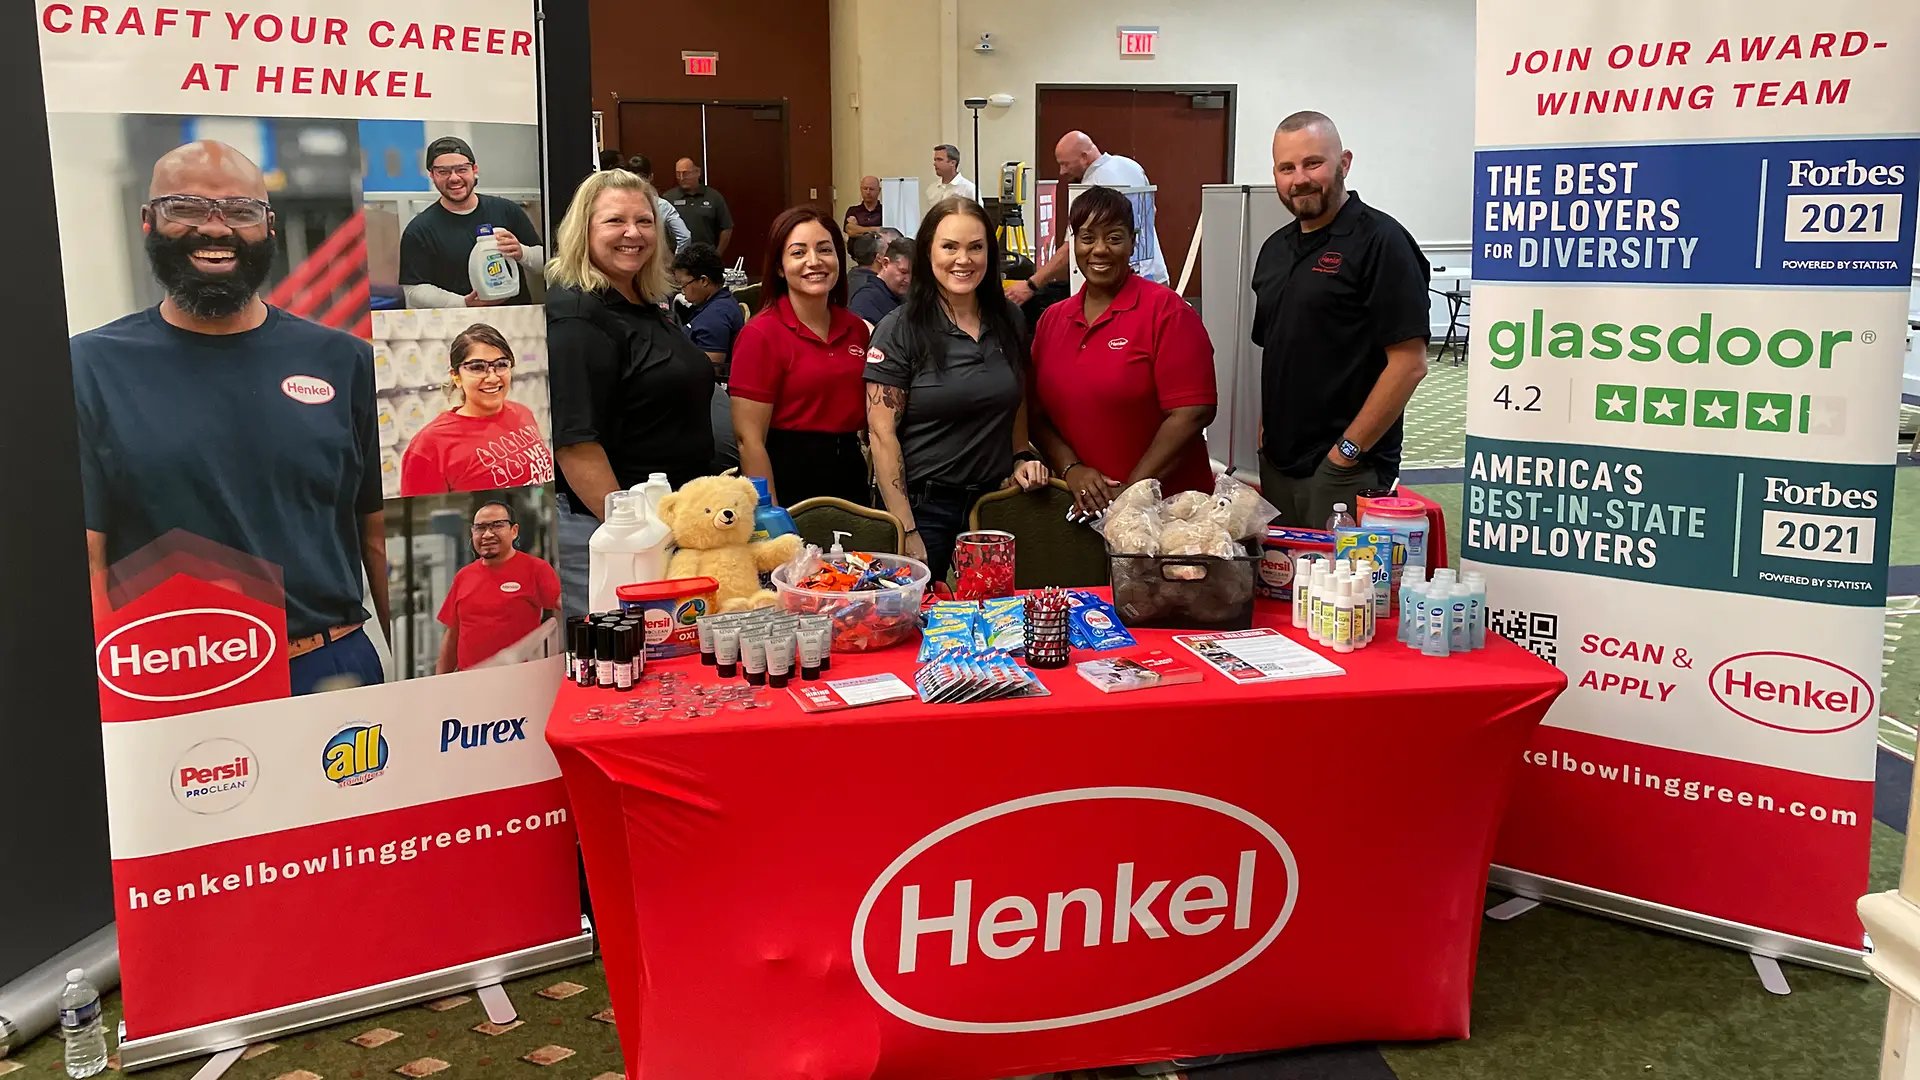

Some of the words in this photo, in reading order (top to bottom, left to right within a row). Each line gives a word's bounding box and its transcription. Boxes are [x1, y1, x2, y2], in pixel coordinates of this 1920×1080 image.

[42, 3, 211, 38] CRAFT
[224, 12, 348, 46] YOUR
[369, 20, 533, 56] CAREER
[1127, 33, 1152, 52] EXIT
[1506, 46, 1591, 76] JOIN
[1608, 41, 1691, 69] OUR
[1706, 31, 1888, 64] AWARD-
[181, 63, 238, 91] AT
[256, 66, 432, 98] HENKEL
[1537, 84, 1714, 117] WINNING
[1733, 79, 1851, 108] TEAM
[1487, 164, 1541, 196] THE
[1555, 161, 1639, 195] BEST
[1787, 159, 1905, 188] Forbes
[1485, 199, 1680, 232] EMPLOYERS
[1800, 203, 1884, 234] 2021
[488, 261, 502, 276] all
[1484, 244, 1513, 259] FOR
[1519, 237, 1699, 269] DIVERSITY
[1782, 260, 1834, 270] POWERED
[1837, 260, 1850, 270] BY
[1851, 260, 1898, 270] STATISTA
[1488, 308, 1853, 370] glassdoor
[287, 381, 331, 396] Henkel
[1493, 384, 1542, 412] 4.2
[523, 443, 546, 461] WE
[530, 455, 551, 479] ARE
[1470, 451, 1644, 493] AMERICA'S
[1763, 476, 1878, 510] Forbes
[1469, 486, 1706, 539] BEST-IN-STATE
[1467, 519, 1658, 570] EMPLOYERS
[1776, 520, 1859, 555] 2021
[1261, 559, 1290, 572] Persil
[1759, 572, 1809, 586] POWERED
[1811, 577, 1824, 587] BY
[1825, 579, 1872, 591] STATISTA
[645, 617, 670, 629] ersil
[679, 632, 695, 641] OXI
[110, 628, 258, 677] Henkel
[1580, 634, 1664, 665] SCAN
[1672, 648, 1693, 669] &
[1578, 670, 1676, 702] APPLY
[1725, 668, 1858, 714] Henkel
[440, 717, 527, 752] Purex
[326, 724, 382, 780] all
[180, 757, 249, 787] Persil
[186, 781, 246, 798] PROCLEAN
[129, 807, 568, 910] henkelbowlinggreen.com
[897, 849, 1257, 974] Henkel
